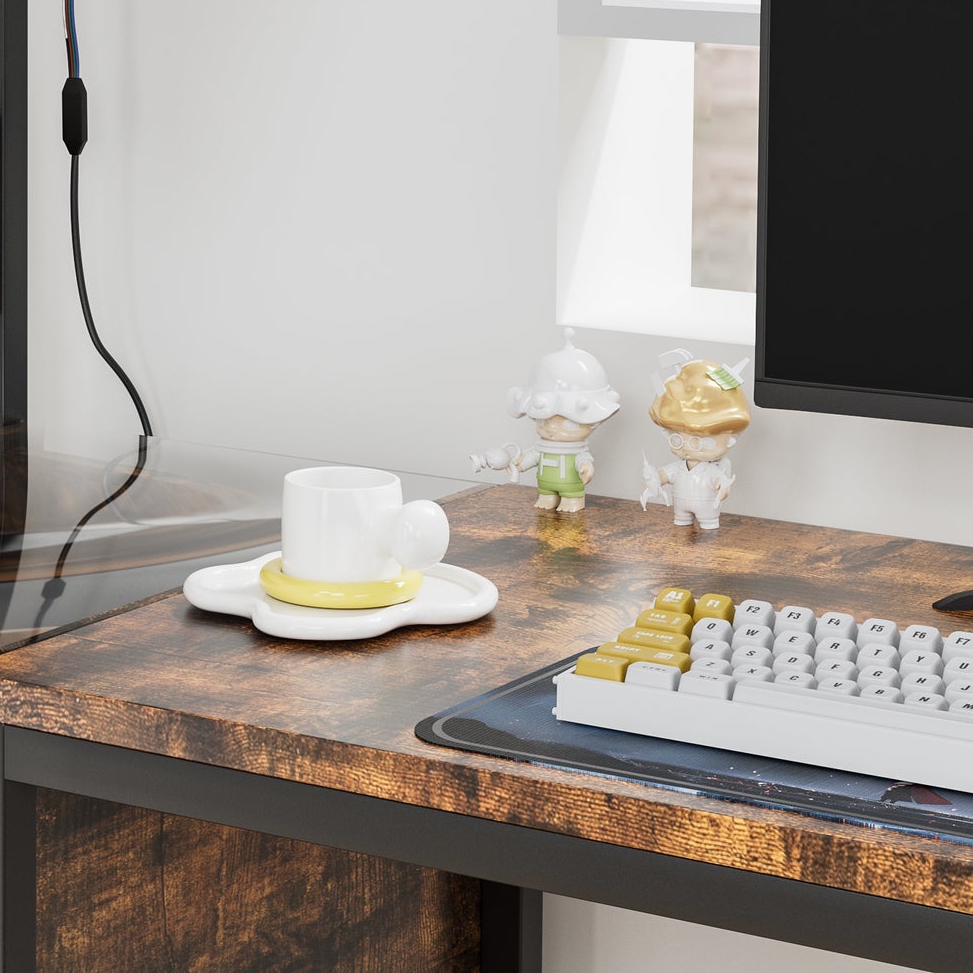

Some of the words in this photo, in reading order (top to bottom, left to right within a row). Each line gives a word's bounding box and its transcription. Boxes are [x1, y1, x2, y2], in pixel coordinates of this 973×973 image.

[707, 600, 720, 608] F1
[827, 618, 841, 626] F4
[870, 624, 885, 633] F5
[912, 631, 927, 639] F6
[955, 637, 971, 646] F7
[829, 642, 840, 650] R
[959, 662, 970, 670] U
